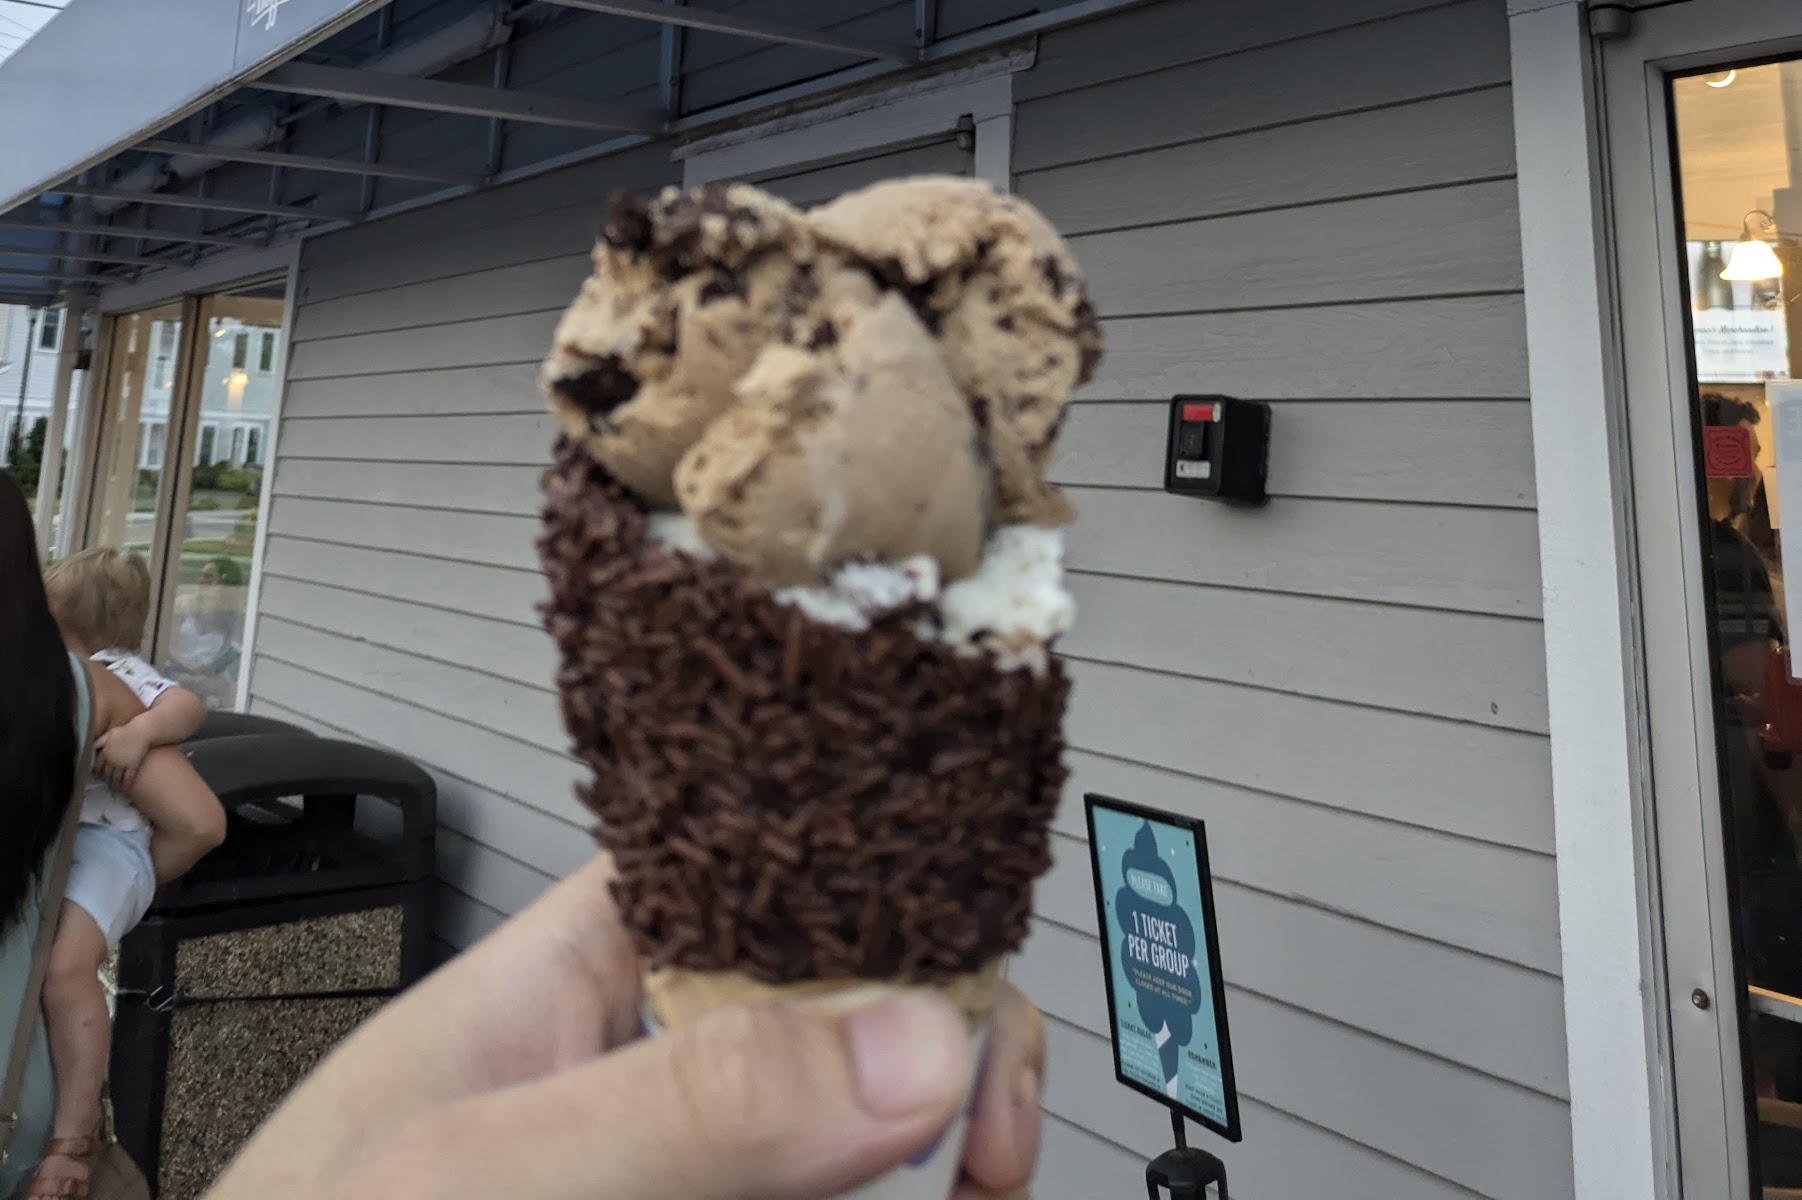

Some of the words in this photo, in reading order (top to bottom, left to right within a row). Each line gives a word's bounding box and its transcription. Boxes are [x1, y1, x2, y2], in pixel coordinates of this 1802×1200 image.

[1130, 873, 1152, 892] PLEASE
[1152, 881, 1168, 898] TAKE
[1132, 910, 1140, 934] 1
[1141, 912, 1178, 949] TICKET
[1128, 933, 1149, 964] PER
[1151, 942, 1190, 978] GROUP
